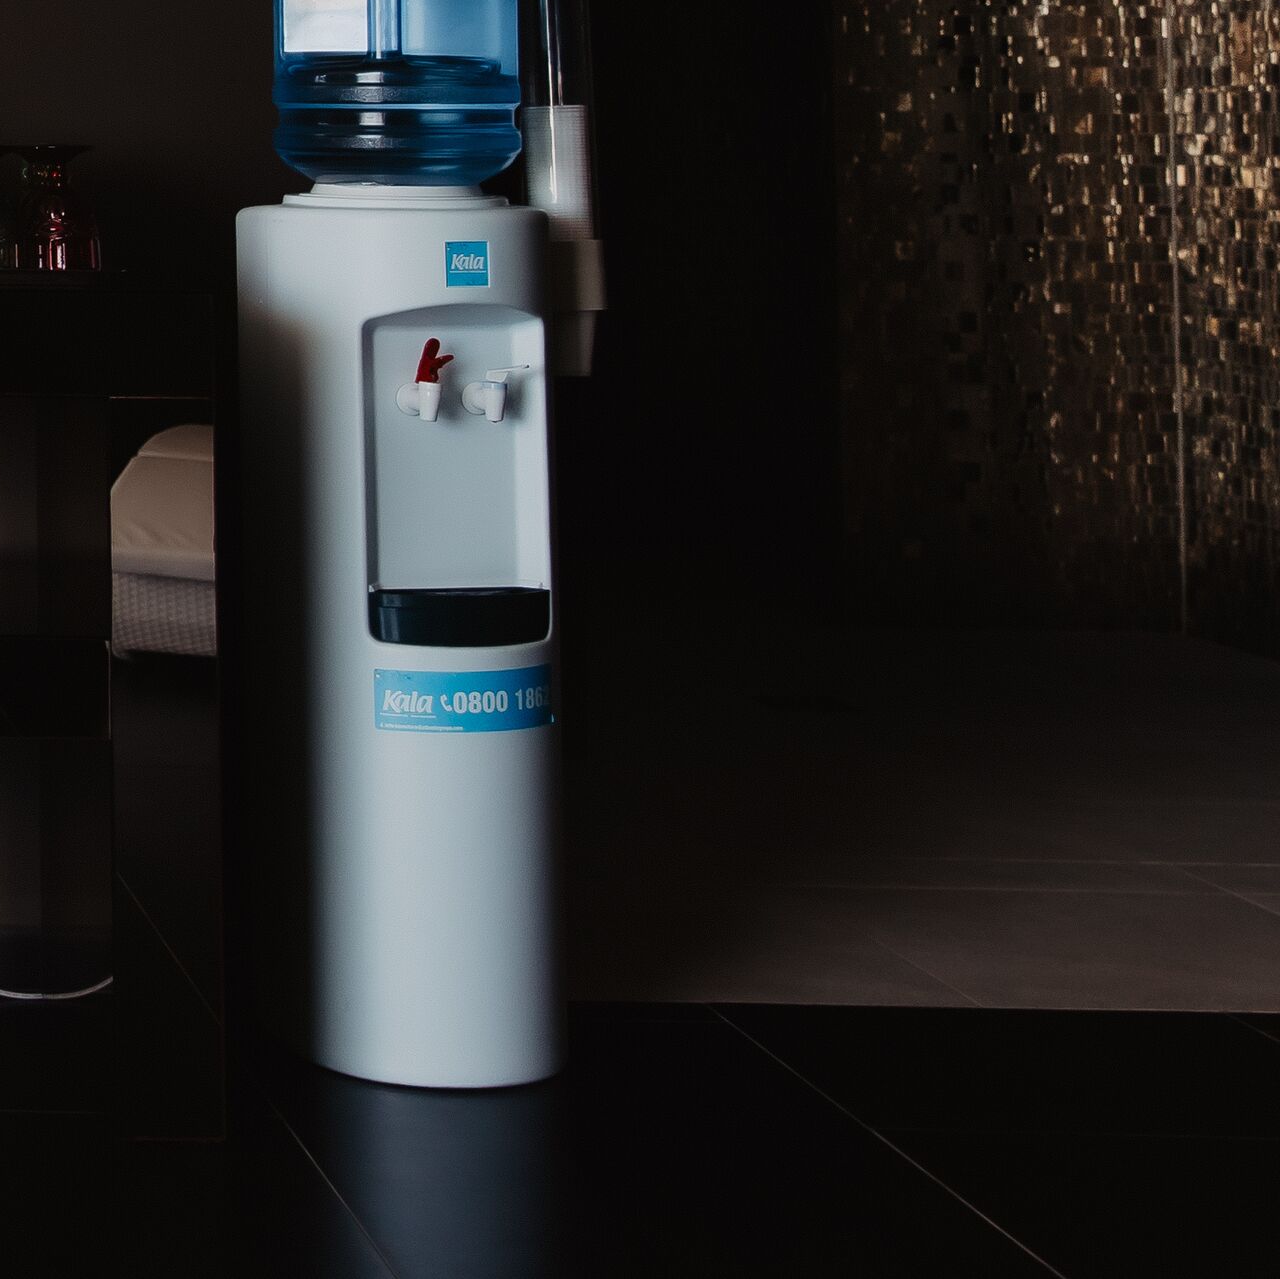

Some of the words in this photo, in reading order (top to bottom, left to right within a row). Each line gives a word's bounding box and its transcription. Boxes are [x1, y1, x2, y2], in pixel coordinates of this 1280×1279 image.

[450, 253, 485, 271] Kala
[382, 689, 433, 714] Kala
[452, 690, 509, 714] 0800
